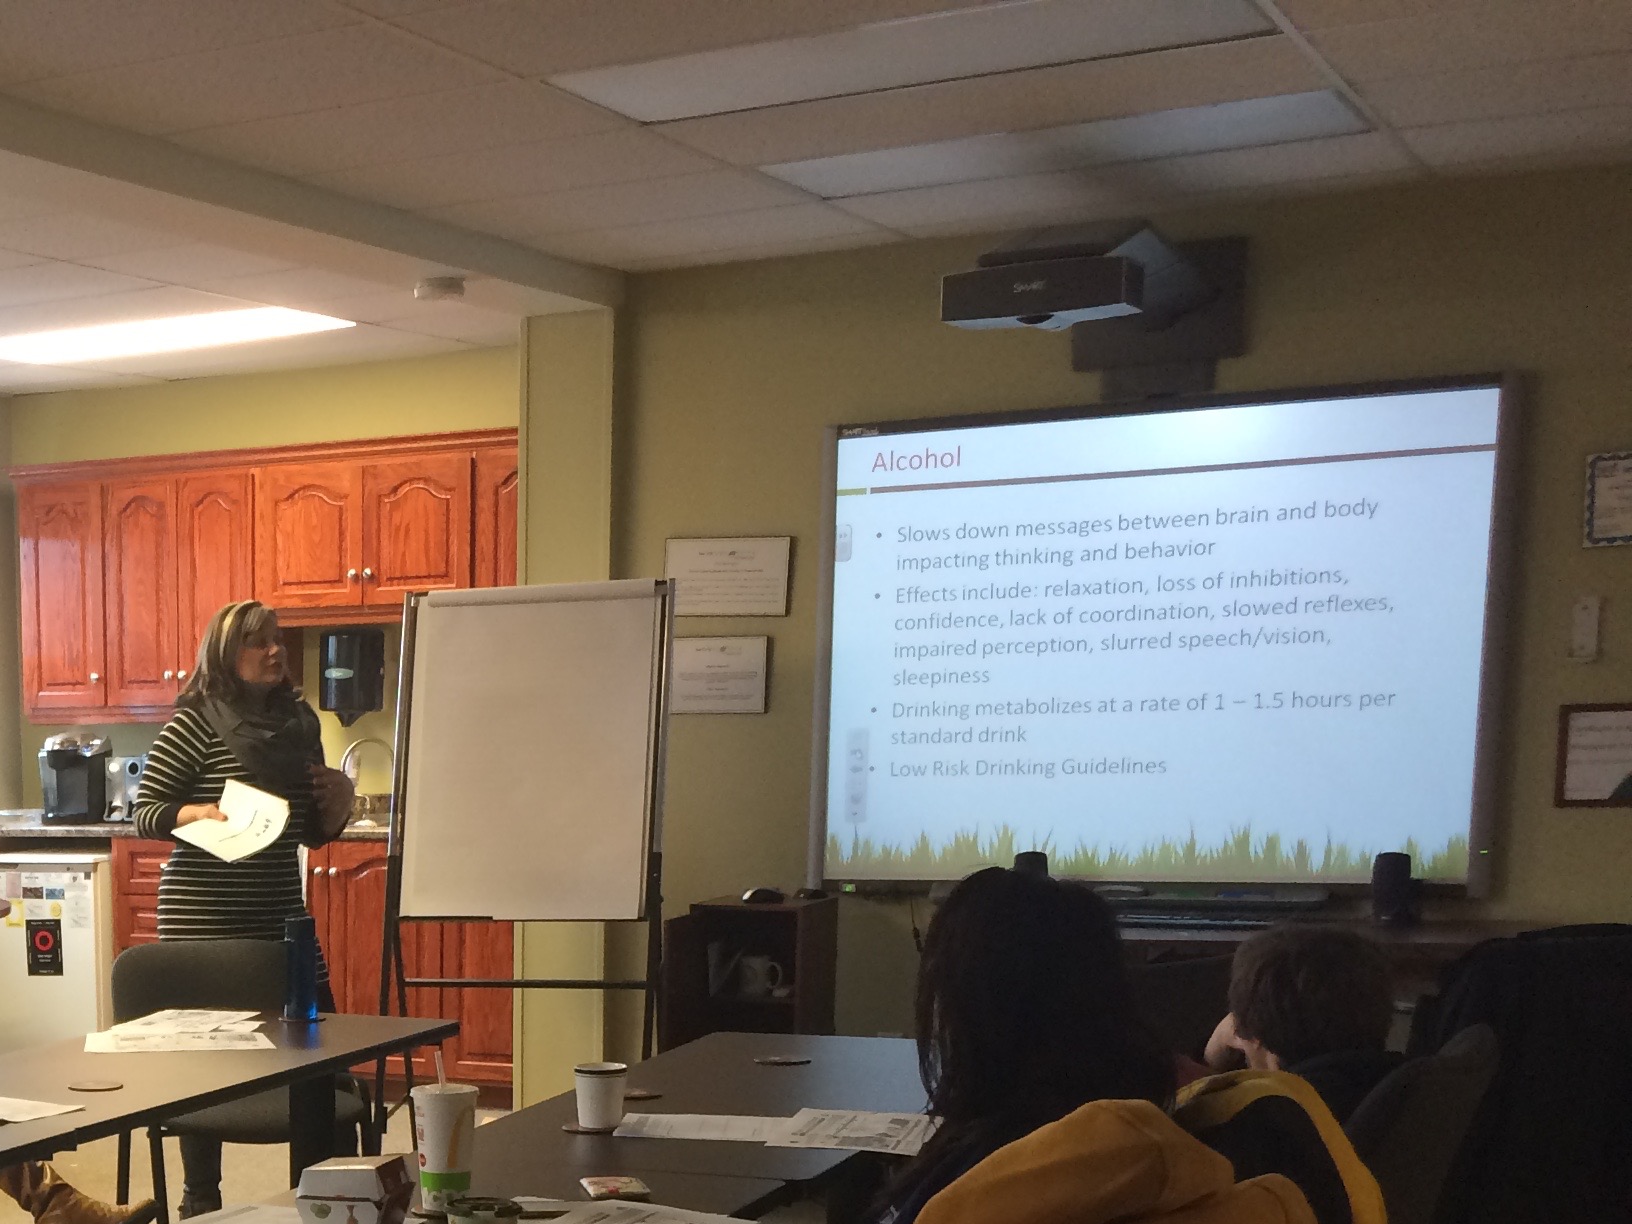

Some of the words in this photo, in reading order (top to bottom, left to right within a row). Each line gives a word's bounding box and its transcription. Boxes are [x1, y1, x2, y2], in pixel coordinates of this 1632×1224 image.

[871, 444, 961, 473] Alcohol
[897, 525, 951, 543] Slows
[955, 522, 1009, 540] down
[1015, 518, 1113, 538] messages
[1119, 512, 1210, 532] between
[1215, 505, 1269, 526] brain
[1276, 500, 1317, 522] and
[1324, 497, 1379, 520] body
[896, 553, 990, 574] impacting
[994, 547, 1074, 568] thinking
[1079, 542, 1118, 562] and
[1124, 539, 1217, 560] behavior
[896, 585, 958, 604] Effects
[962, 581, 1039, 601] include:
[1044, 579, 1149, 598] relaxation,
[1156, 575, 1195, 593] loss
[1201, 572, 1224, 591] of
[1230, 567, 1349, 589] inhibitions,
[894, 611, 1005, 631] confidence,
[1009, 607, 1047, 627] lack
[1052, 606, 1074, 625] of
[1078, 602, 1215, 624] coordination,
[1221, 596, 1298, 618] slowed
[1304, 593, 1394, 614] reflexes,
[894, 638, 977, 662] impaired
[982, 637, 1094, 660] perception,
[1100, 631, 1172, 651] slurred
[1178, 626, 1331, 652] speech/vision,
[893, 667, 990, 689] sleepiness
[892, 700, 970, 721] Drinking
[975, 696, 1092, 716] metabolizes
[1096, 697, 1118, 713] at
[1122, 699, 1133, 713] a
[1140, 696, 1181, 712] rate
[1186, 692, 1208, 711] of
[1214, 693, 1225, 711] 1
[1253, 691, 1284, 710] 1.5
[1291, 690, 1353, 709] hours
[1359, 692, 1397, 711] per
[892, 726, 973, 745] standard
[978, 725, 1027, 743] drink
[890, 761, 928, 778] Low
[932, 759, 970, 777] Risk
[975, 758, 1056, 780] Drinking
[1061, 756, 1167, 775] Guidelines
